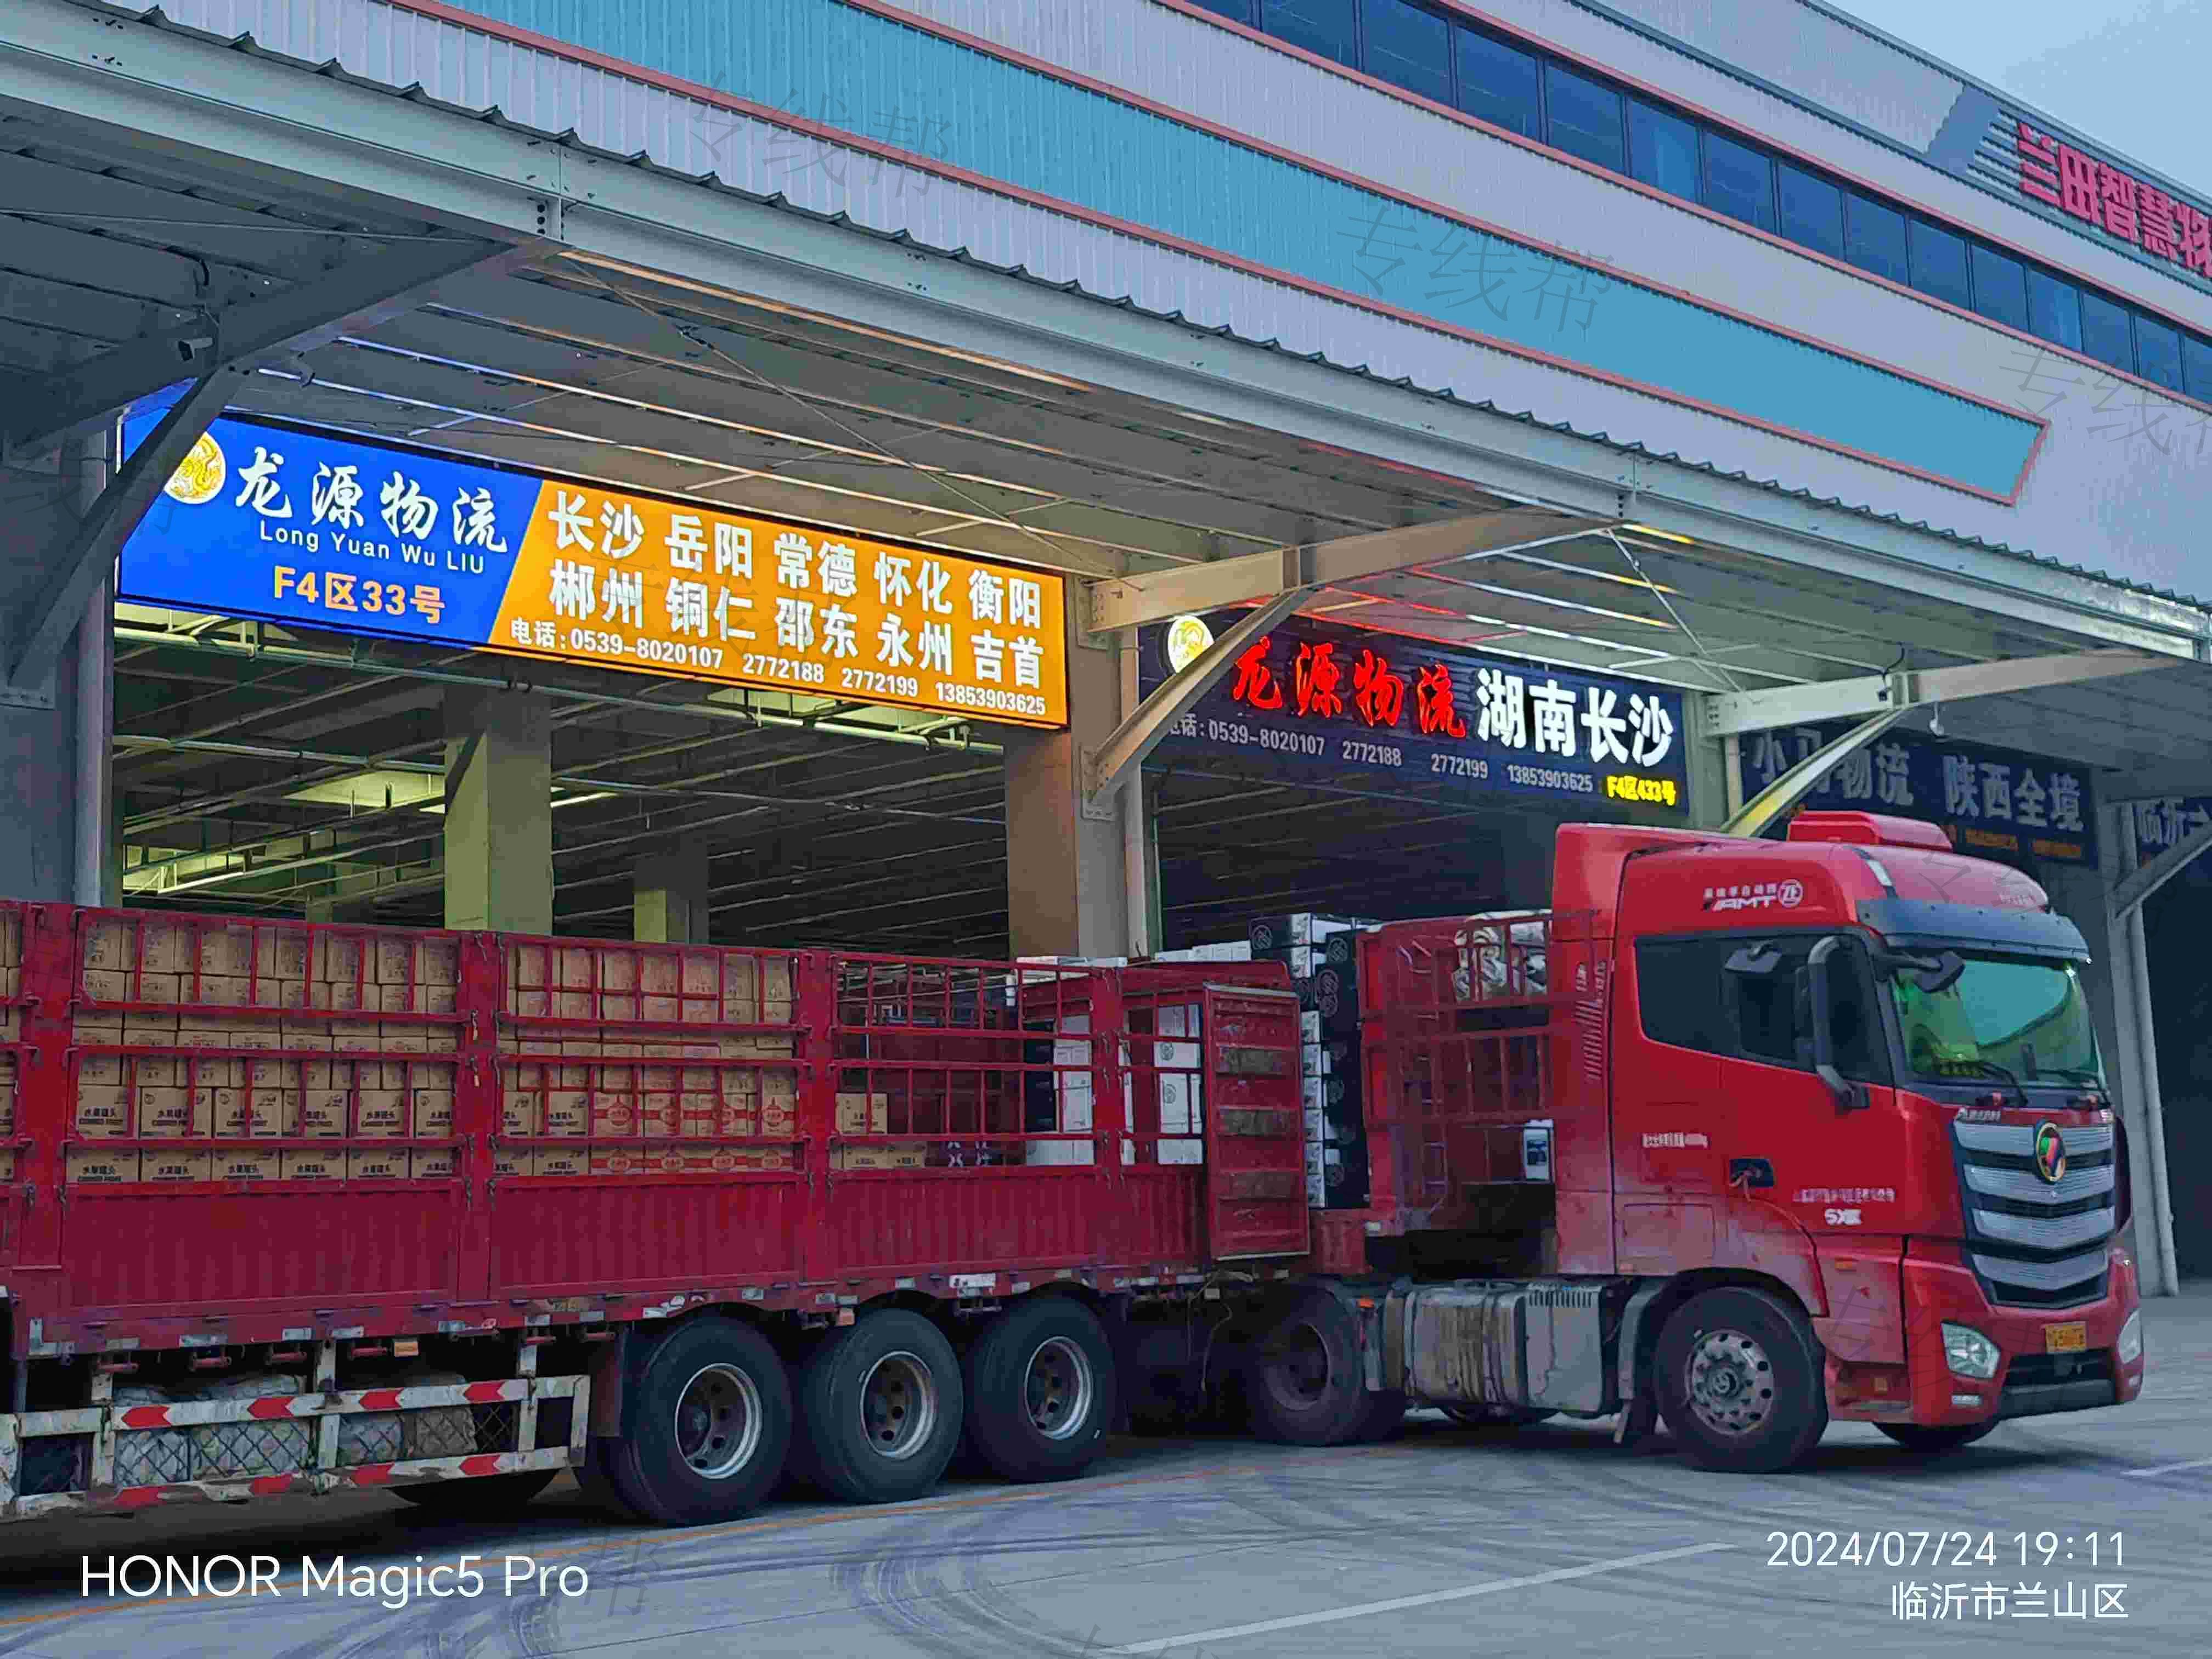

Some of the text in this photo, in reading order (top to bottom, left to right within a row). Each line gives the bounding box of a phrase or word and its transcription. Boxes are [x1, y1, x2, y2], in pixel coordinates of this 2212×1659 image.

[235, 446, 508, 553] 龙源物流
[261, 521, 484, 574] Long Yuan Wu LIU
[549, 490, 1041, 629] 长沙 岳阳 常德 怀化 衡阳
[274, 565, 445, 624] F4区33号
[549, 560, 1043, 689] 郴州 铜仁 邵东 永州 吉首
[742, 653, 824, 684] 2772188
[841, 668, 918, 697] 2772199
[935, 681, 1045, 715] 13853903625
[1233, 636, 1673, 767] 龙源物流 湖南长沙
[1342, 740, 1402, 768] 2772188
[1430, 753, 1488, 781] 2772199
[1506, 763, 1593, 793] 13853903625
[1943, 754, 2084, 832] 陕西全境
